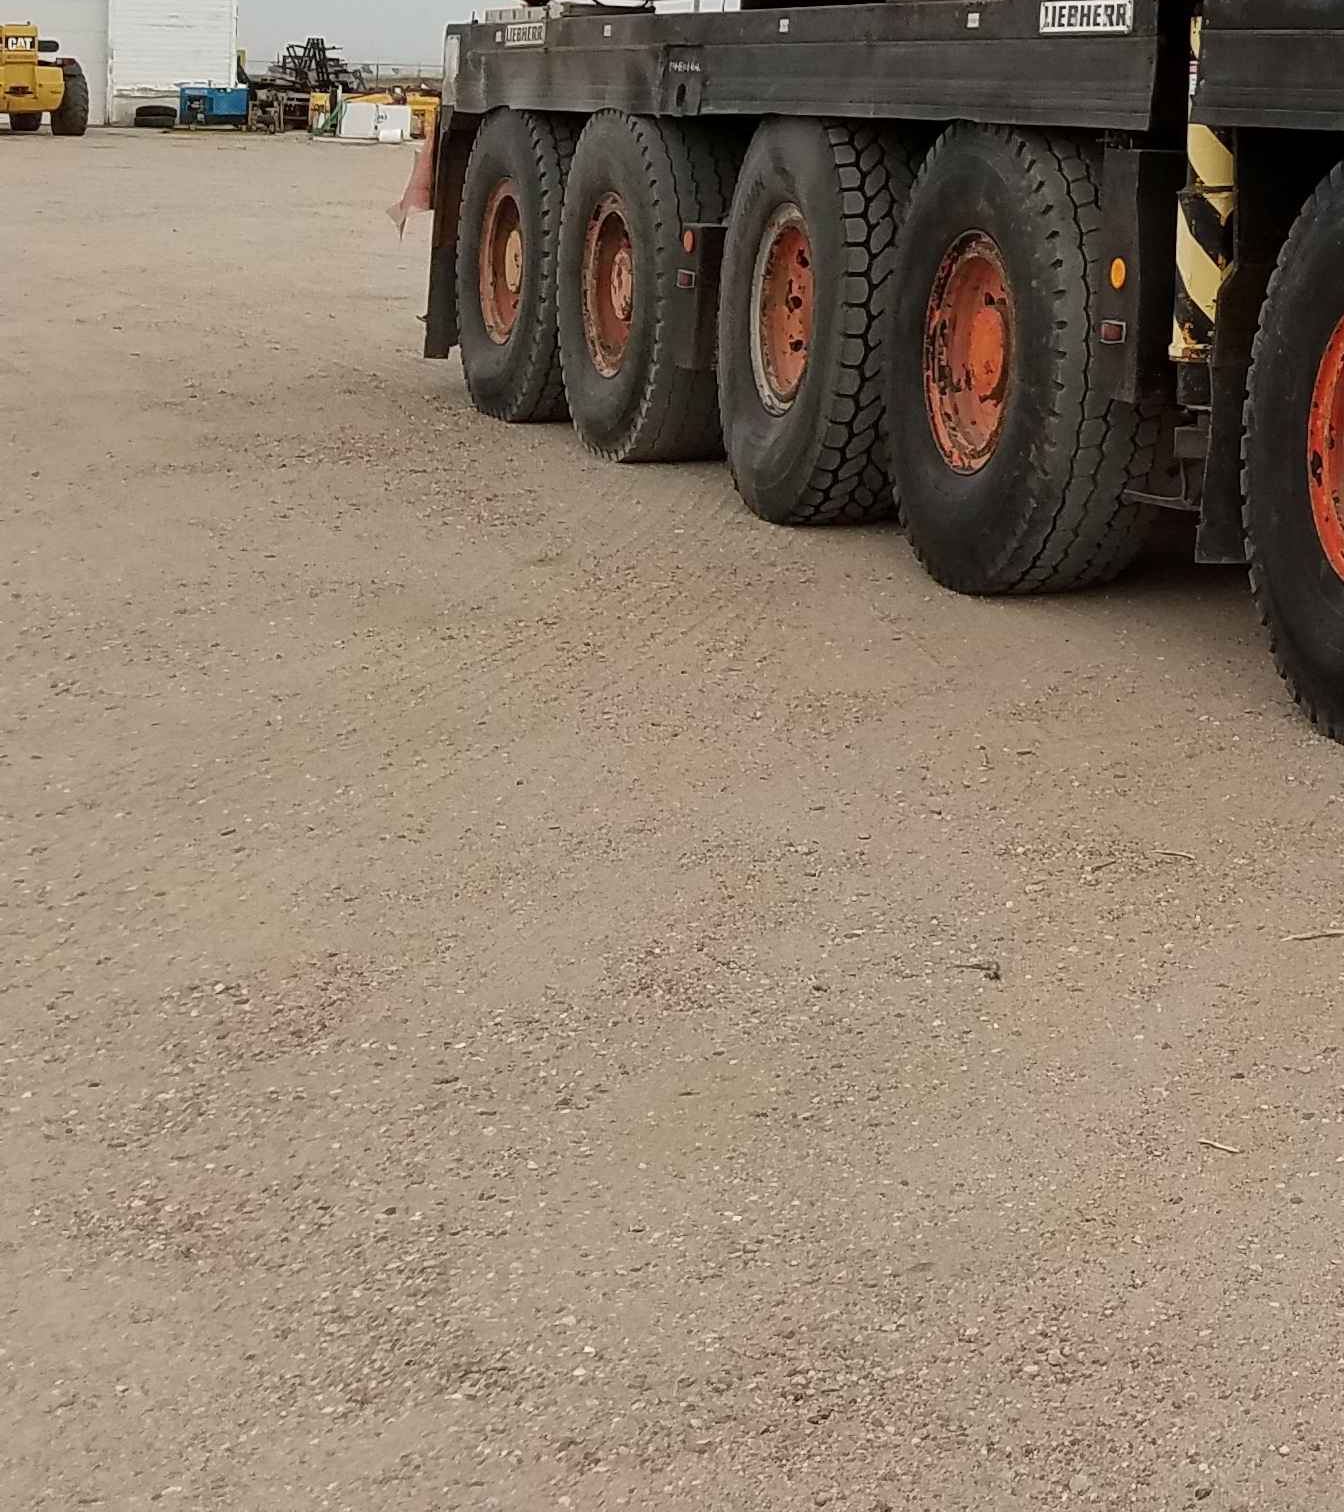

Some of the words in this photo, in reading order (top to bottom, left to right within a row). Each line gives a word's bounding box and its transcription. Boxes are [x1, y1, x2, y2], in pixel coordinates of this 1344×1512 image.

[1043, 3, 1128, 28] LIEBHERR
[506, 26, 544, 41] LIEBHERR
[7, 37, 33, 50] CAT
